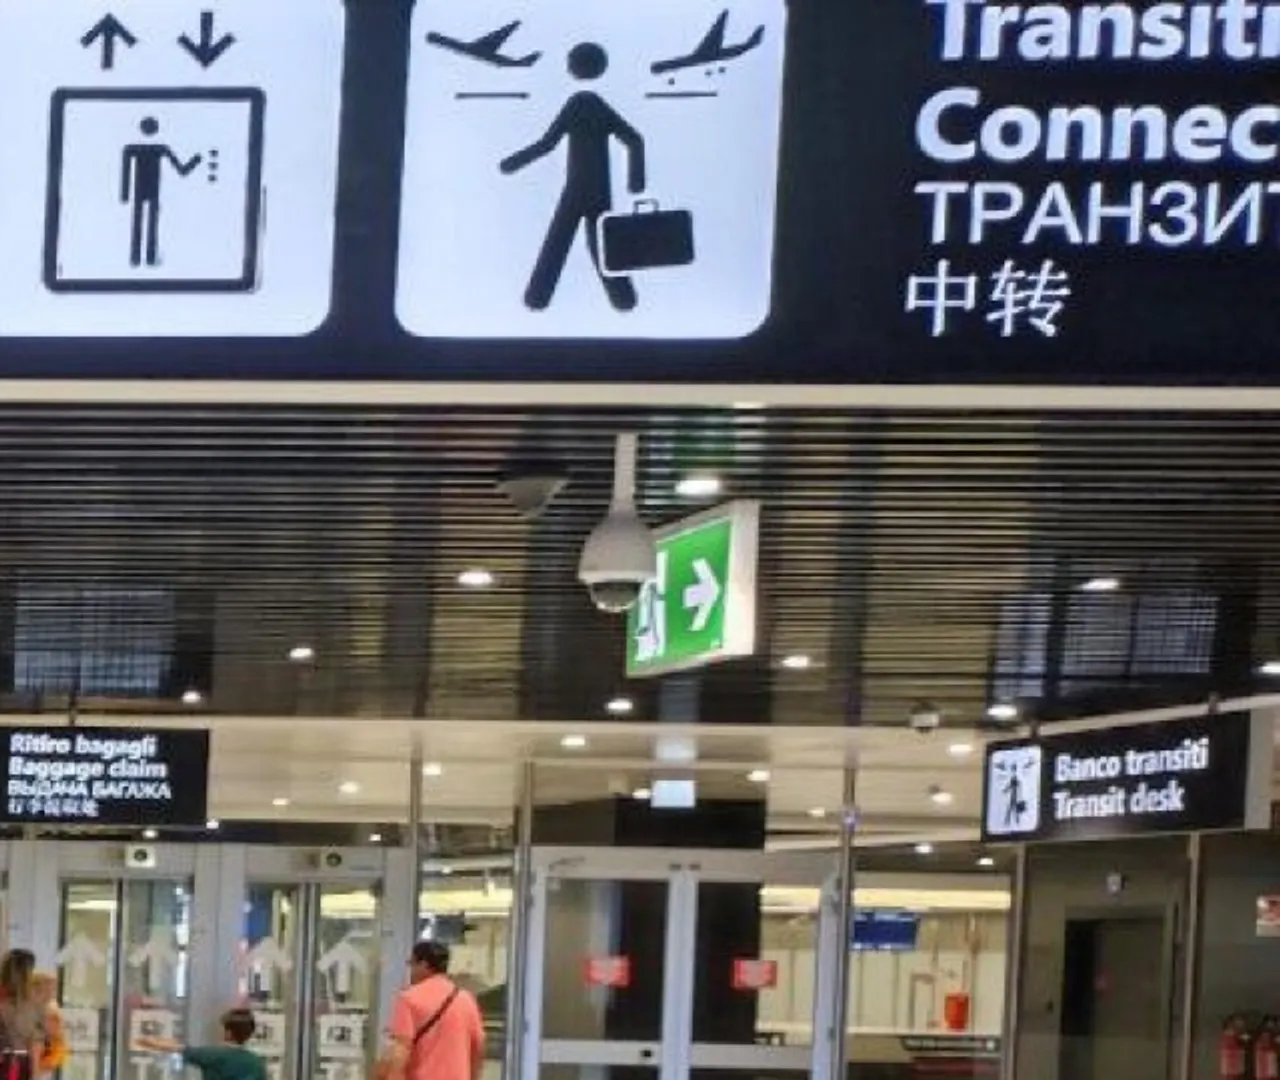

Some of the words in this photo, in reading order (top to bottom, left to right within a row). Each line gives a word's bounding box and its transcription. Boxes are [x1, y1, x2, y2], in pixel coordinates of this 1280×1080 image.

[913, 180, 1280, 246] ТРАНЗИ
[904, 258, 1071, 337] 中转
[10, 734, 71, 753] Ritiro
[75, 734, 157, 759] bagagli
[1055, 754, 1120, 783] Banco
[1124, 737, 1209, 776] transiti
[8, 757, 104, 781] Baggage
[109, 758, 168, 778] claim
[1053, 786, 1125, 820] Transit
[1130, 781, 1184, 813] desk
